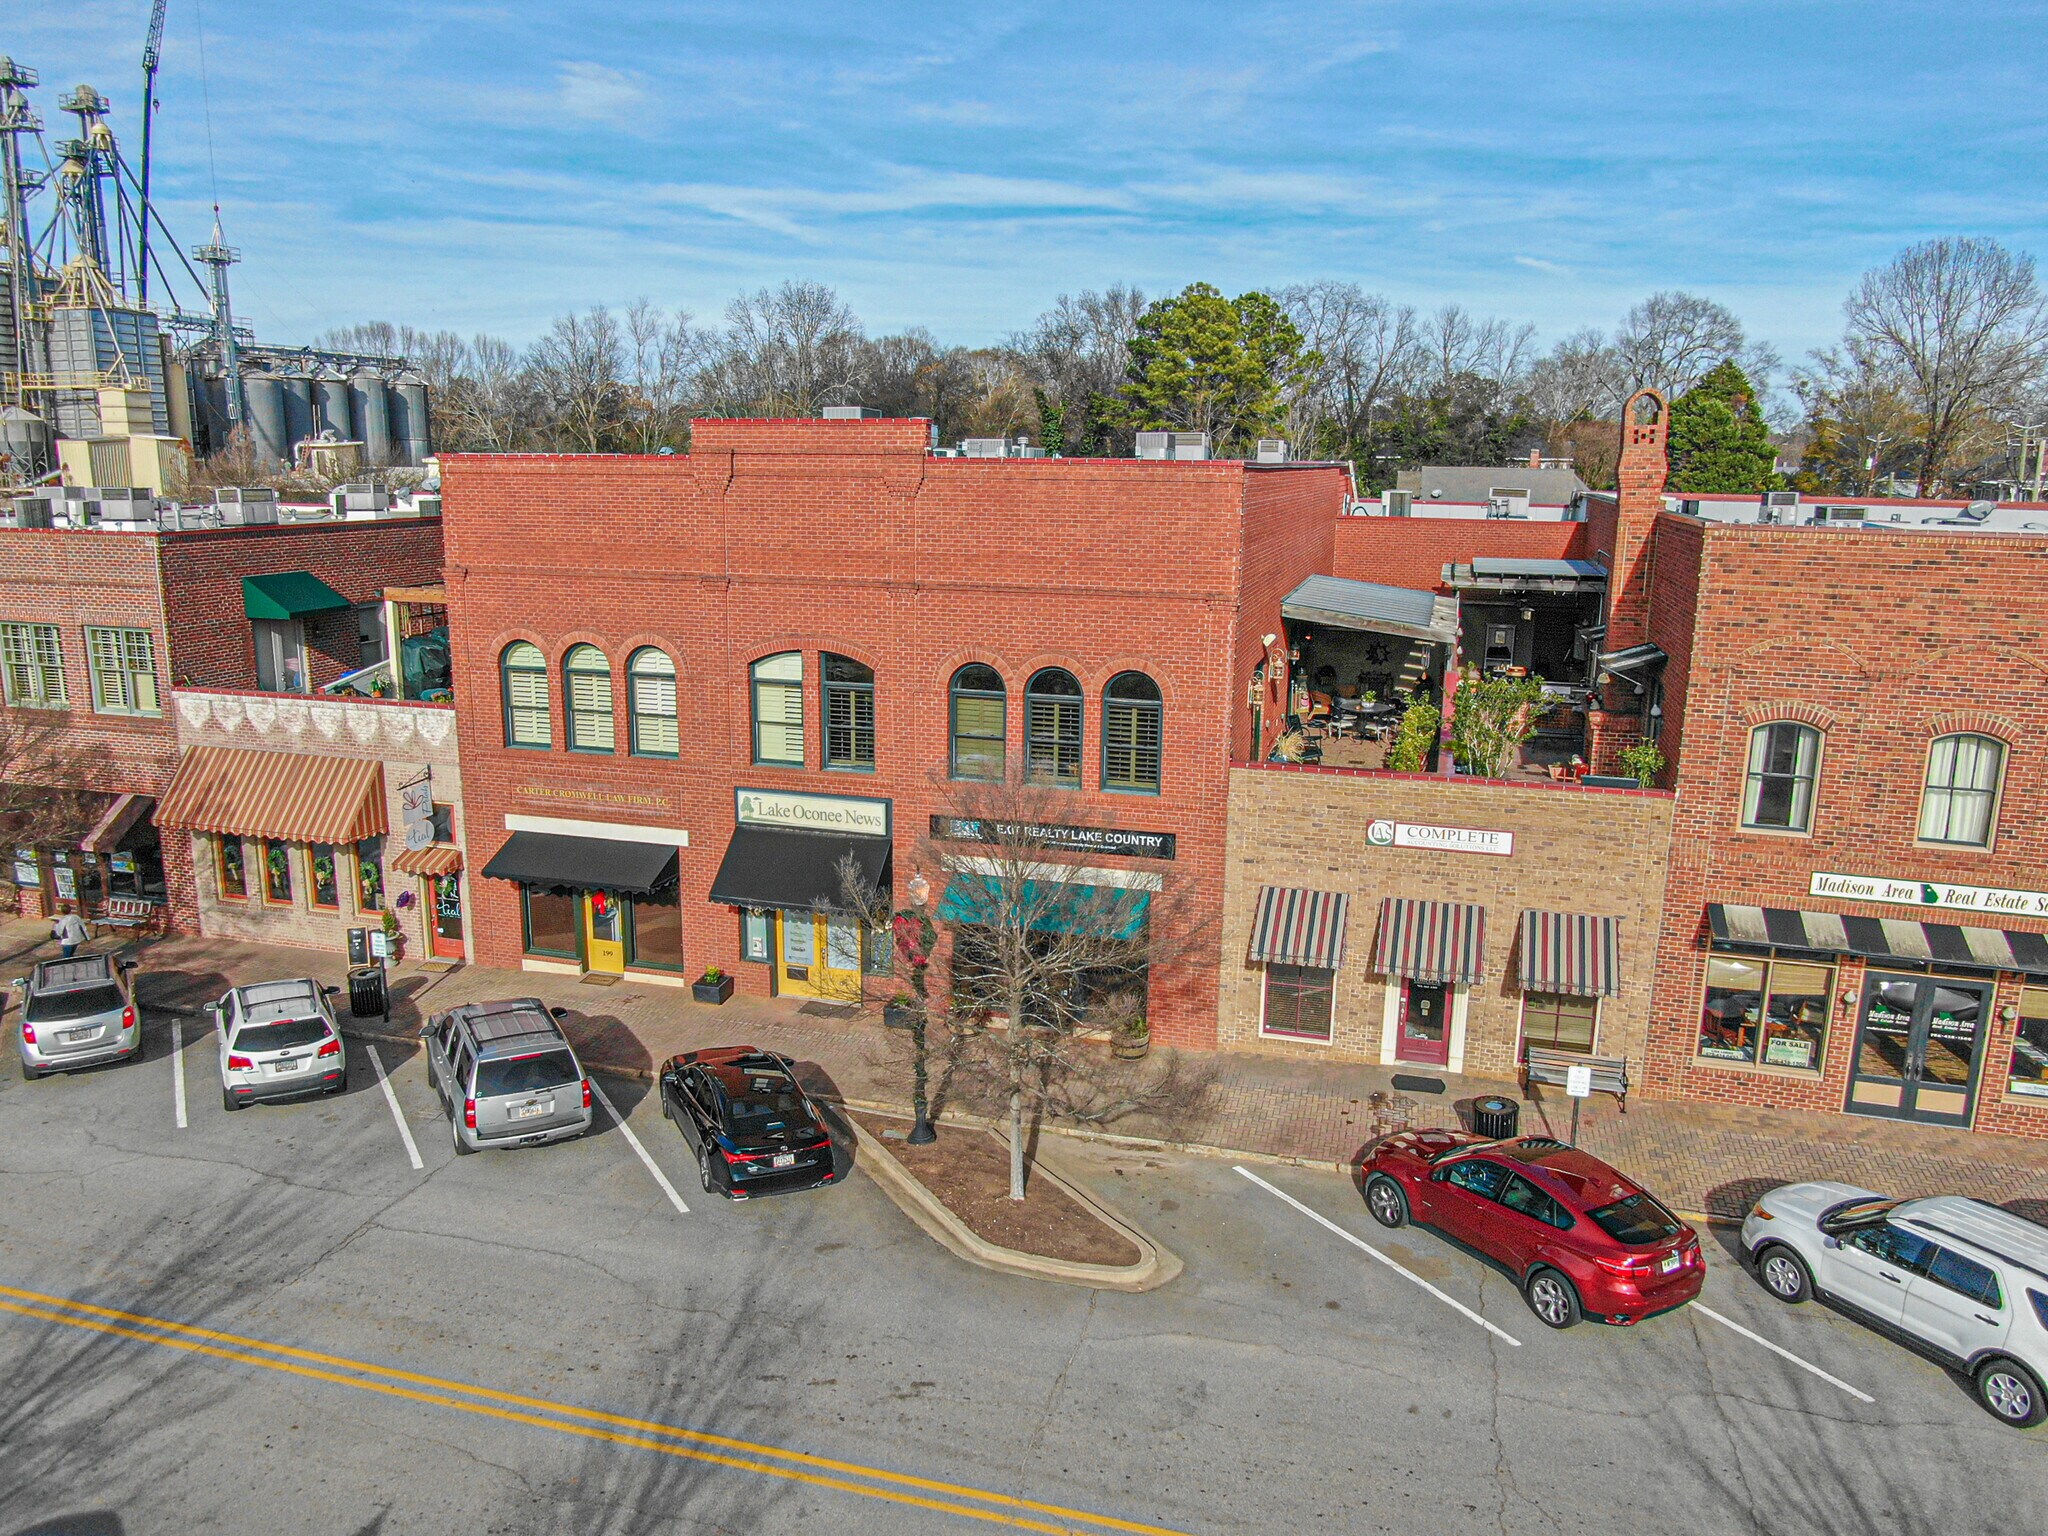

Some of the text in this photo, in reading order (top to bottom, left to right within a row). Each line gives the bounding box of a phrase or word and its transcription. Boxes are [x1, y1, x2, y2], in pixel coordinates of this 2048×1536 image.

[516, 786, 551, 796] CARTER
[553, 789, 603, 801] CROMWELL
[606, 794, 625, 802] LAW
[758, 802, 882, 827] Lake Oconee News
[1024, 826, 1069, 839] REALTY
[1071, 829, 1102, 842] LAKE
[1105, 832, 1163, 847] COUNTRY
[1407, 826, 1499, 845] COMPLETE
[1815, 876, 1874, 896] Madison
[1882, 883, 1914, 900] Area
[1944, 888, 1977, 906] Real
[1984, 892, 2028, 910] Estate
[1868, 1010, 1894, 1020] Madison
[1932, 1017, 1959, 1027] Madison
[1770, 1039, 1809, 1050] FOR SALE
